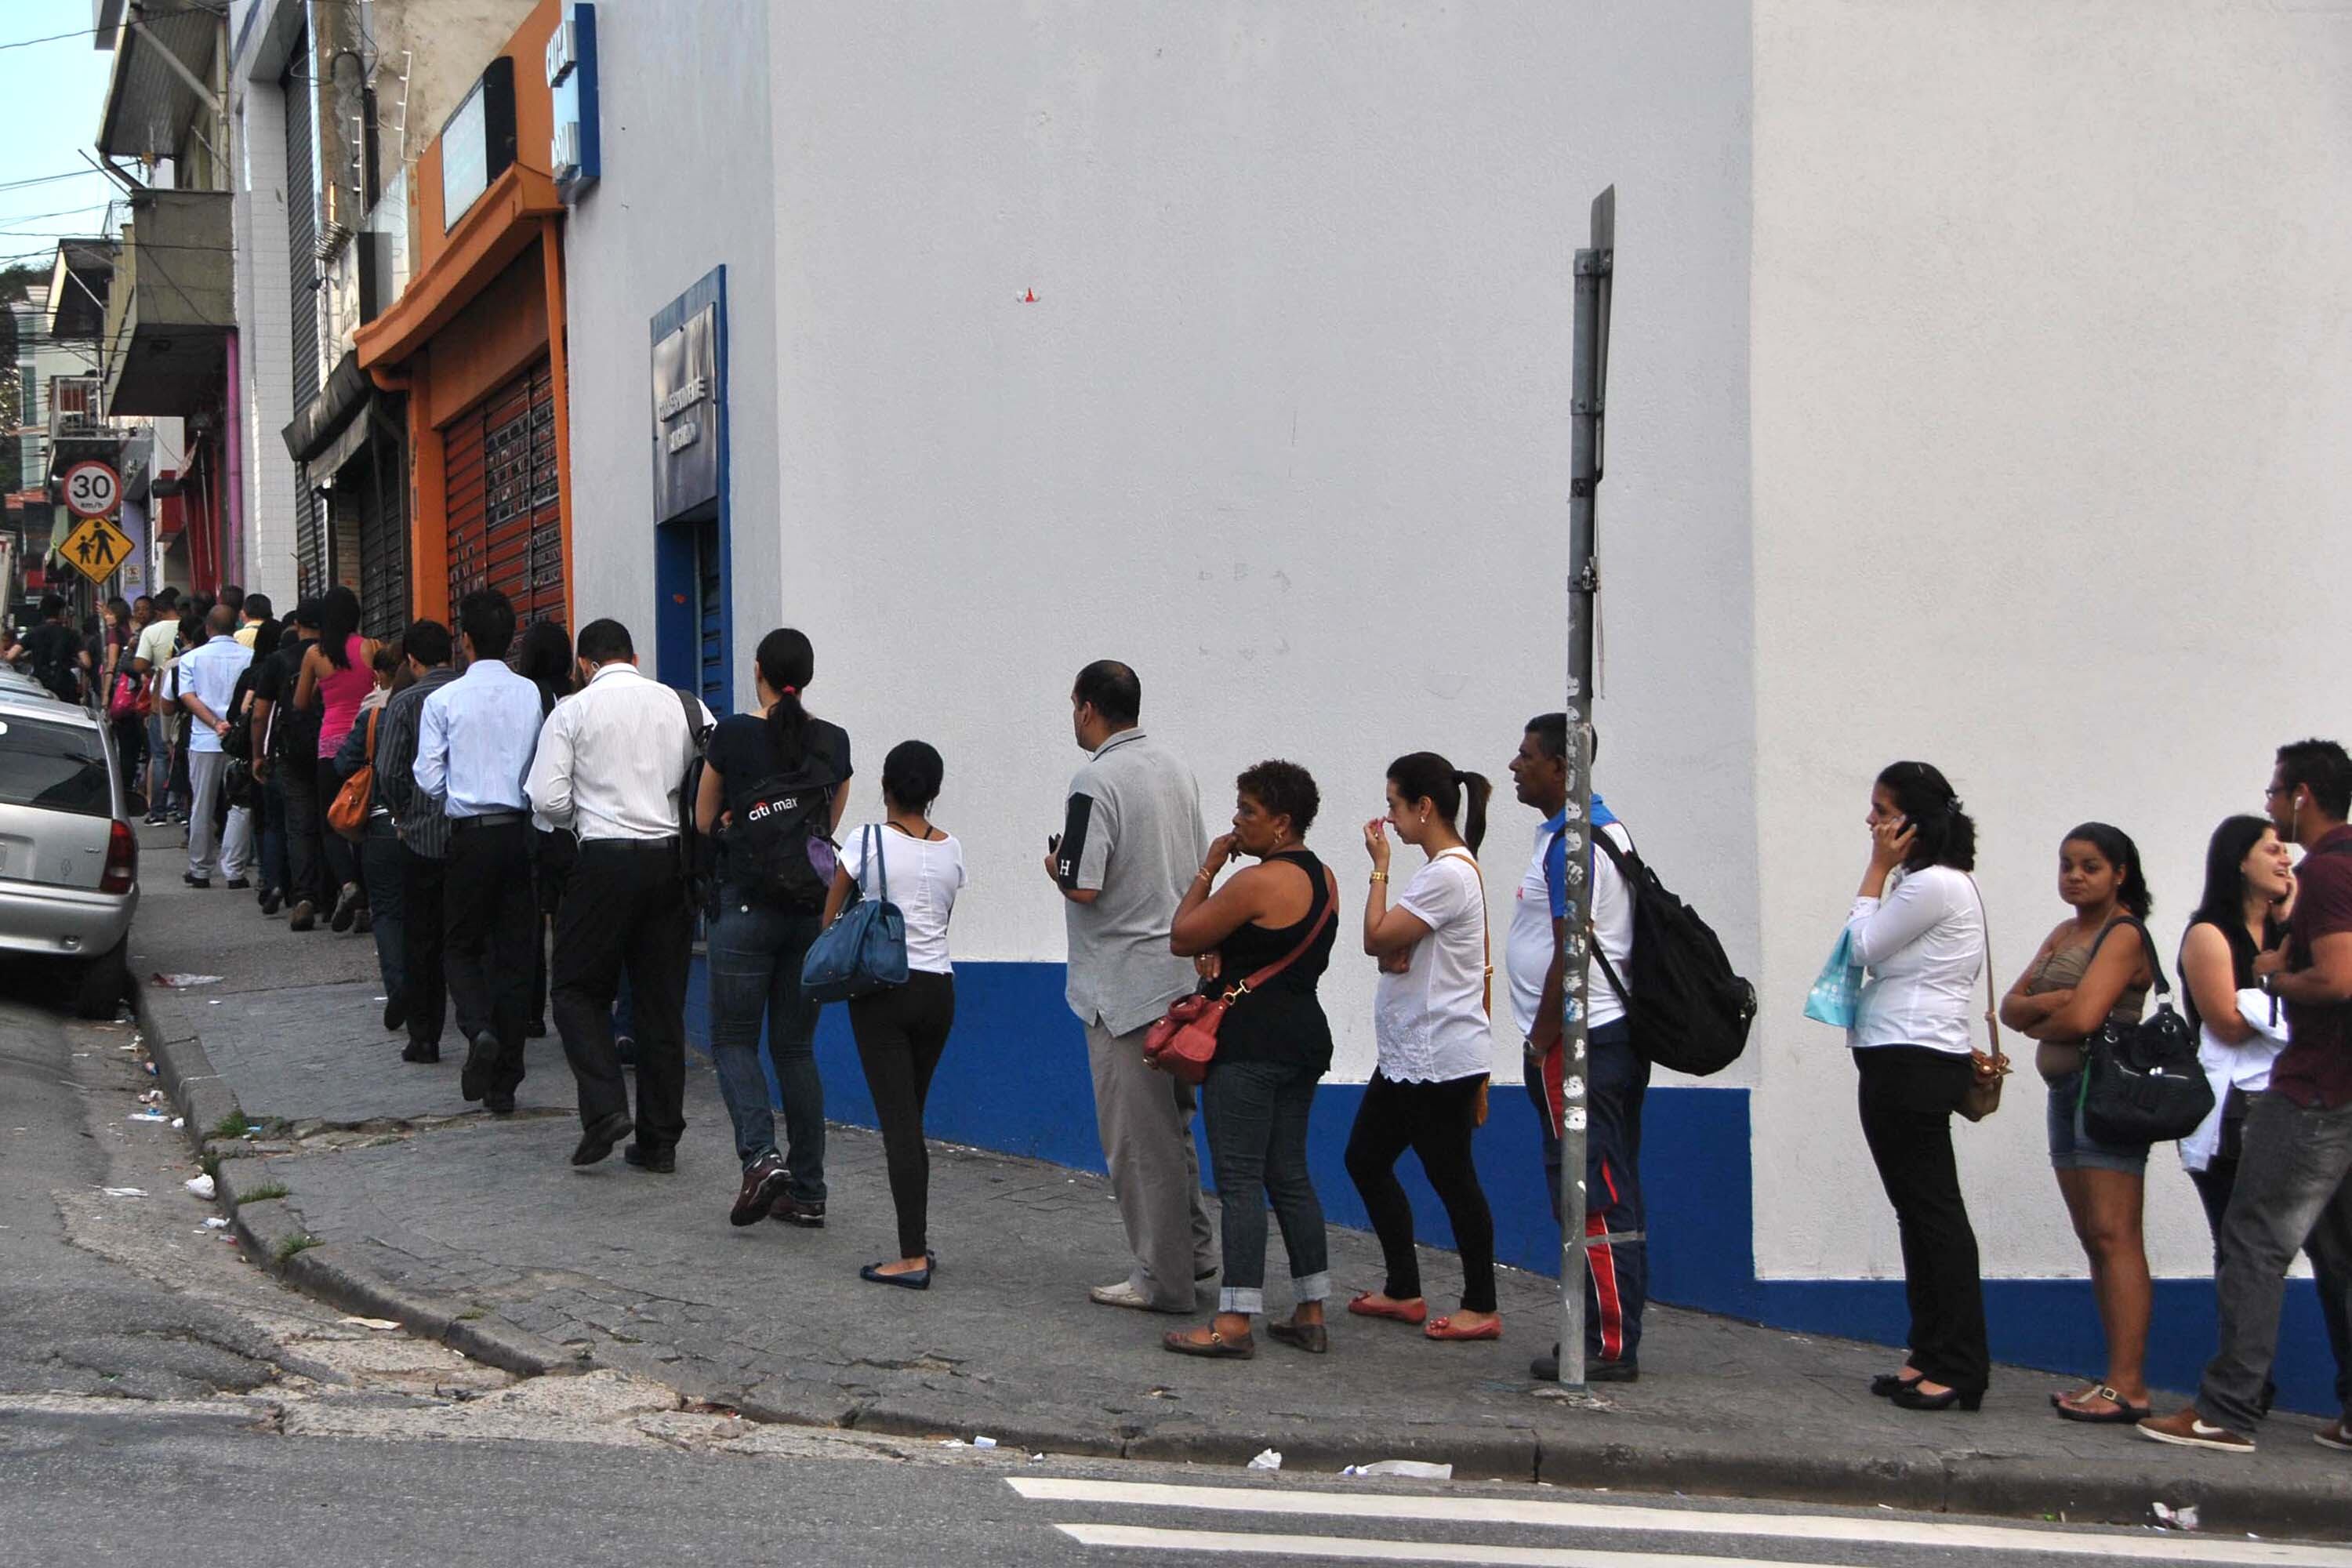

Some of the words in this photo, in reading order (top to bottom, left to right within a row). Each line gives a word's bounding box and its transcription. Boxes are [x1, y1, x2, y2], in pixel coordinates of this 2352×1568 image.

[73, 474, 111, 499] 30
[748, 804, 771, 821] citi
[1059, 859, 1070, 876] H
